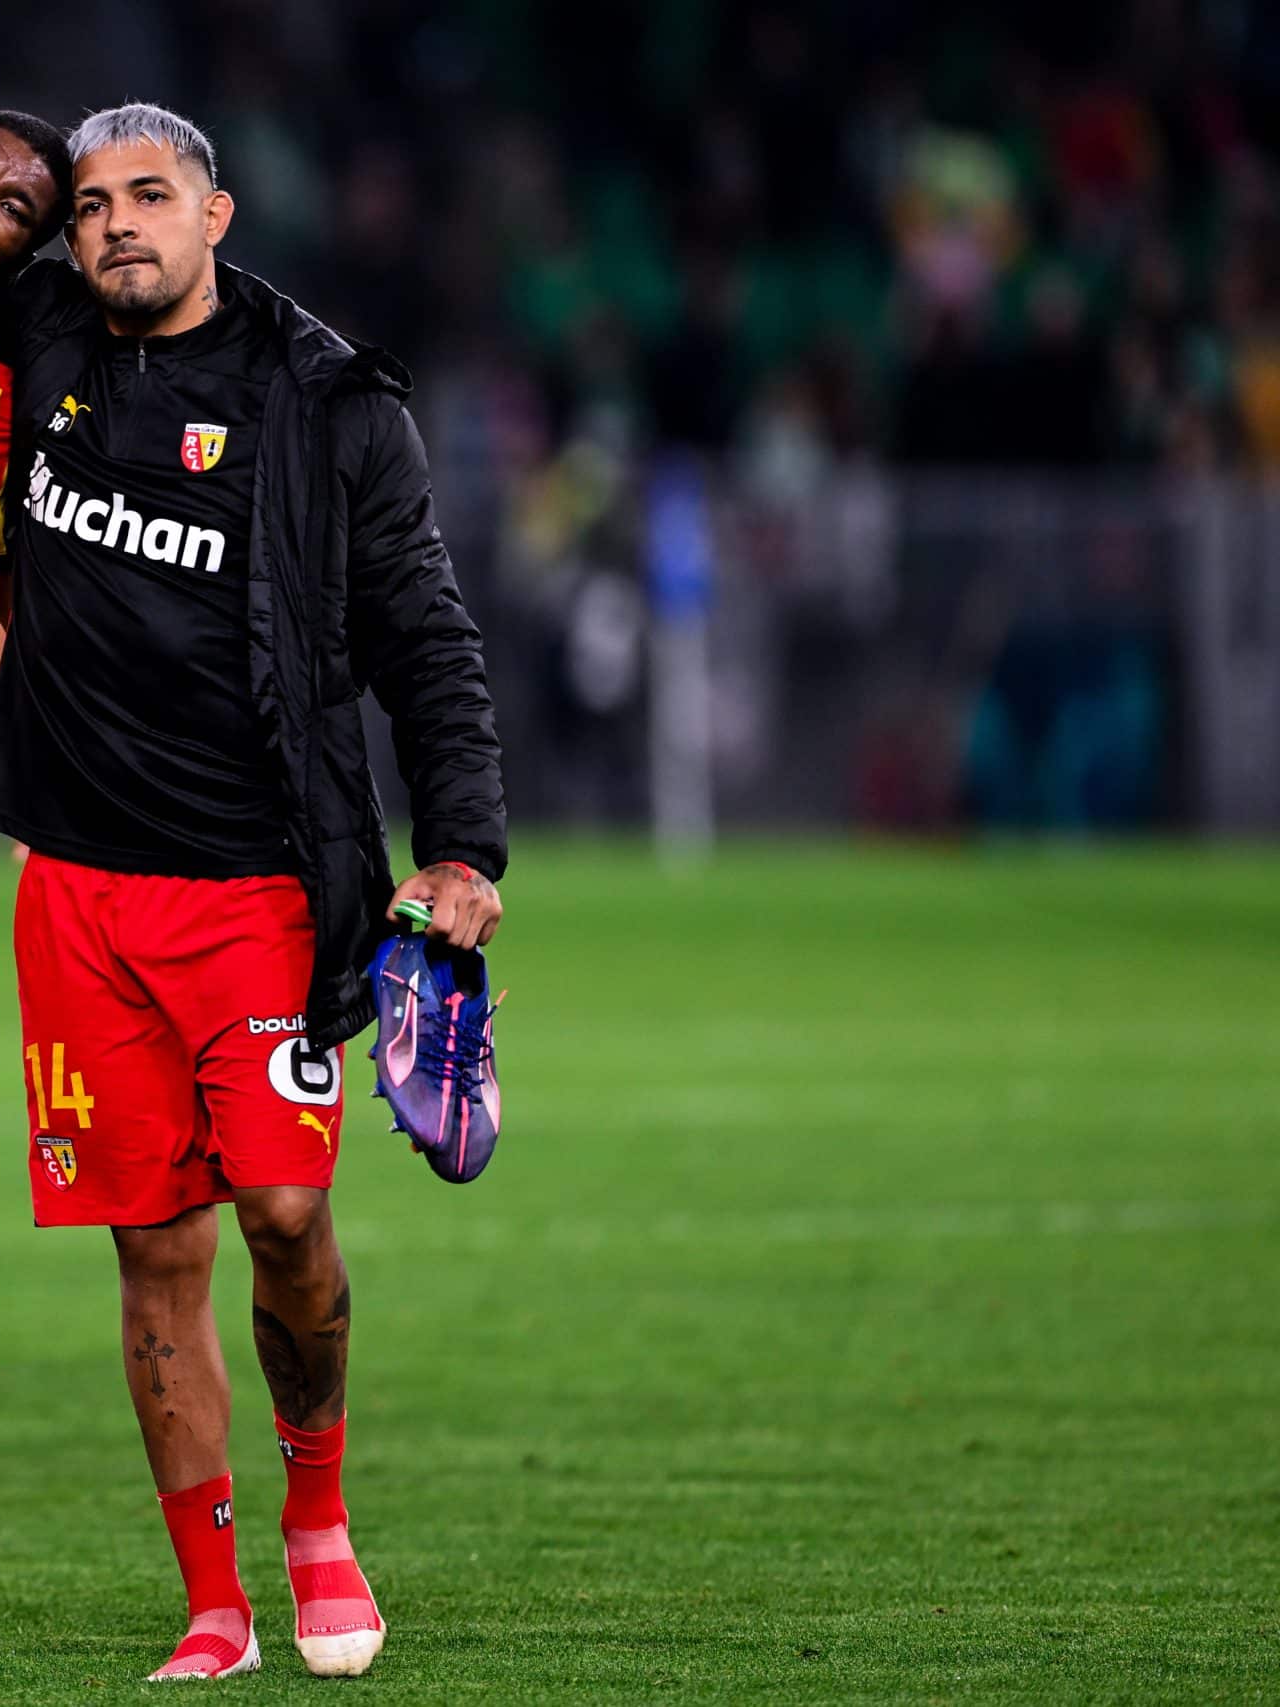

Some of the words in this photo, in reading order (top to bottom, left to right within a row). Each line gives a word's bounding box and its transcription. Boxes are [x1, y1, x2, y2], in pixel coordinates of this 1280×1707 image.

[185, 435, 201, 470] RCL
[23, 450, 225, 573] Auchan
[25, 1042, 95, 1128] 14
[42, 1148, 67, 1186] RCL
[215, 1502, 232, 1526] 14
